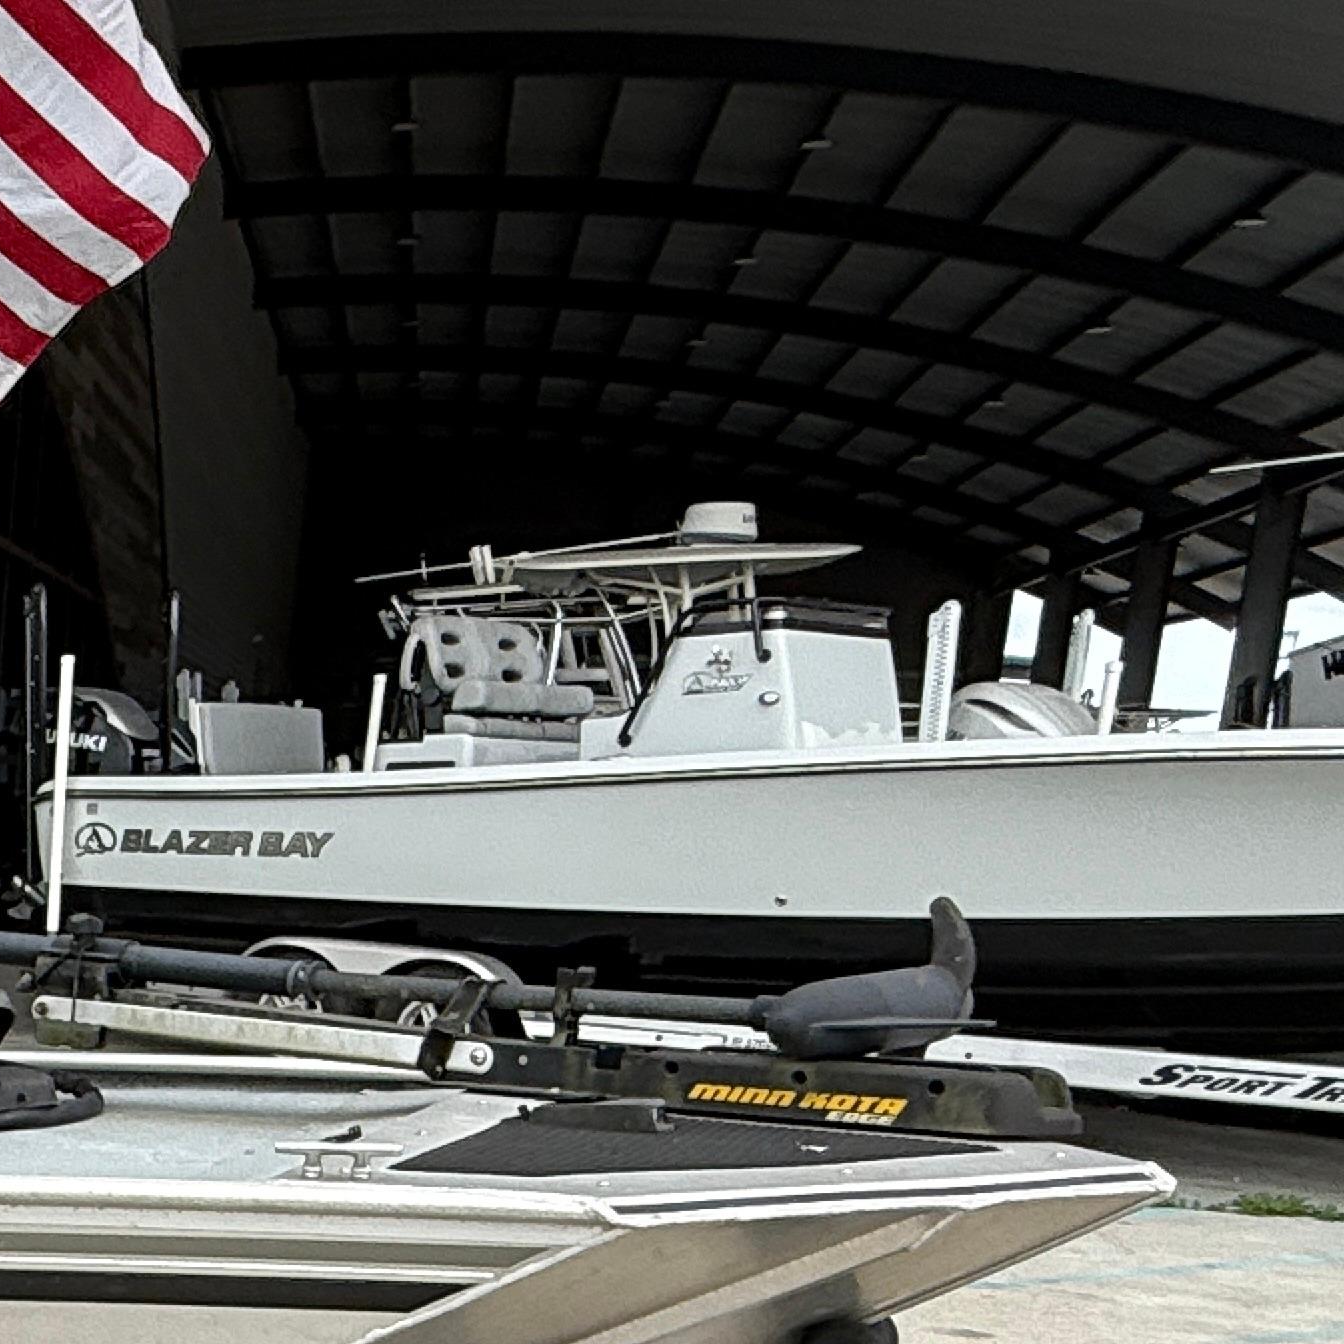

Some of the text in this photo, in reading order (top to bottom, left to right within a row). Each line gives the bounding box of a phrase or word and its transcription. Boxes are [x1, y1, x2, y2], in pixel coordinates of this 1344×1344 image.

[120, 829, 335, 857] BLAZER BAY
[1140, 1064, 1344, 1103] SPORT TR
[799, 1092, 908, 1115] KOTA
